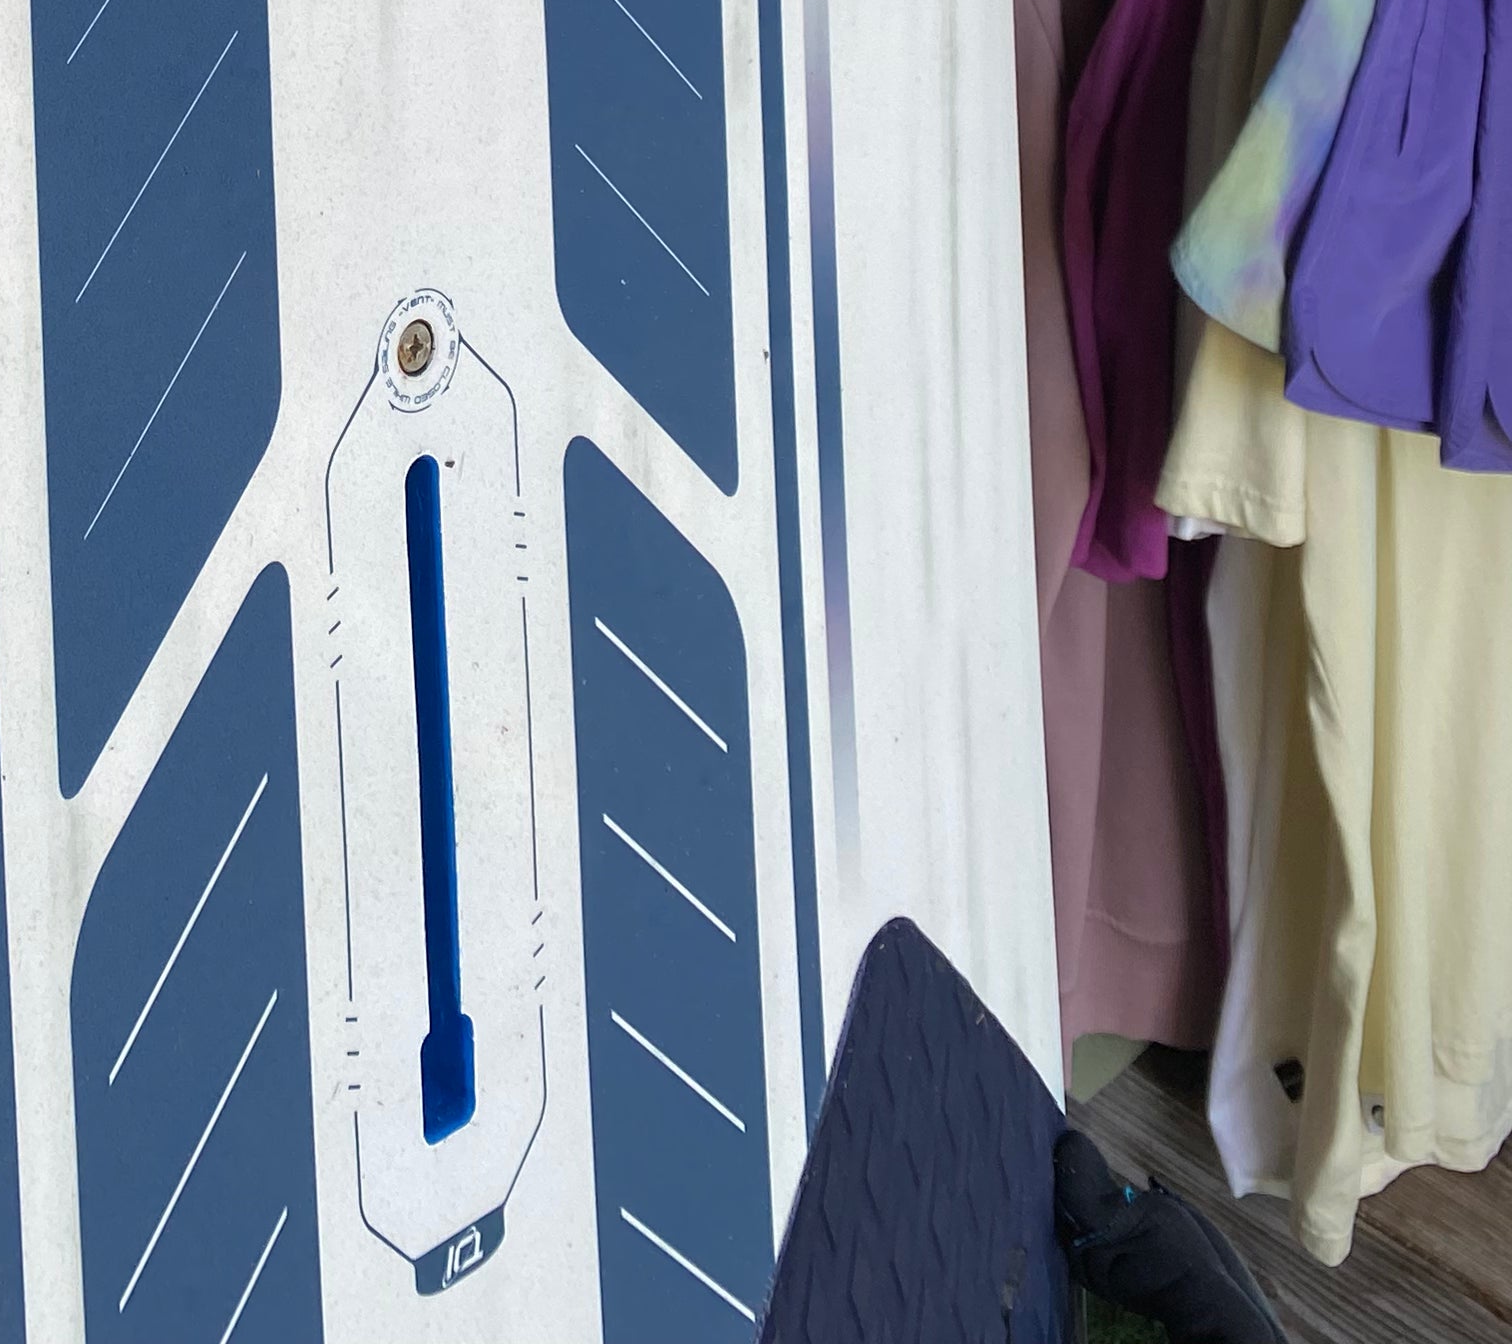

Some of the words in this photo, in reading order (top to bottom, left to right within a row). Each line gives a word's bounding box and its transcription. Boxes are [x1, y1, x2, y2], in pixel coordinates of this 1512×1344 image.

[437, 300, 456, 333] MUST
[382, 321, 396, 373] SAILING
[386, 377, 410, 403] WHILE
[414, 365, 451, 405] CLOSED
